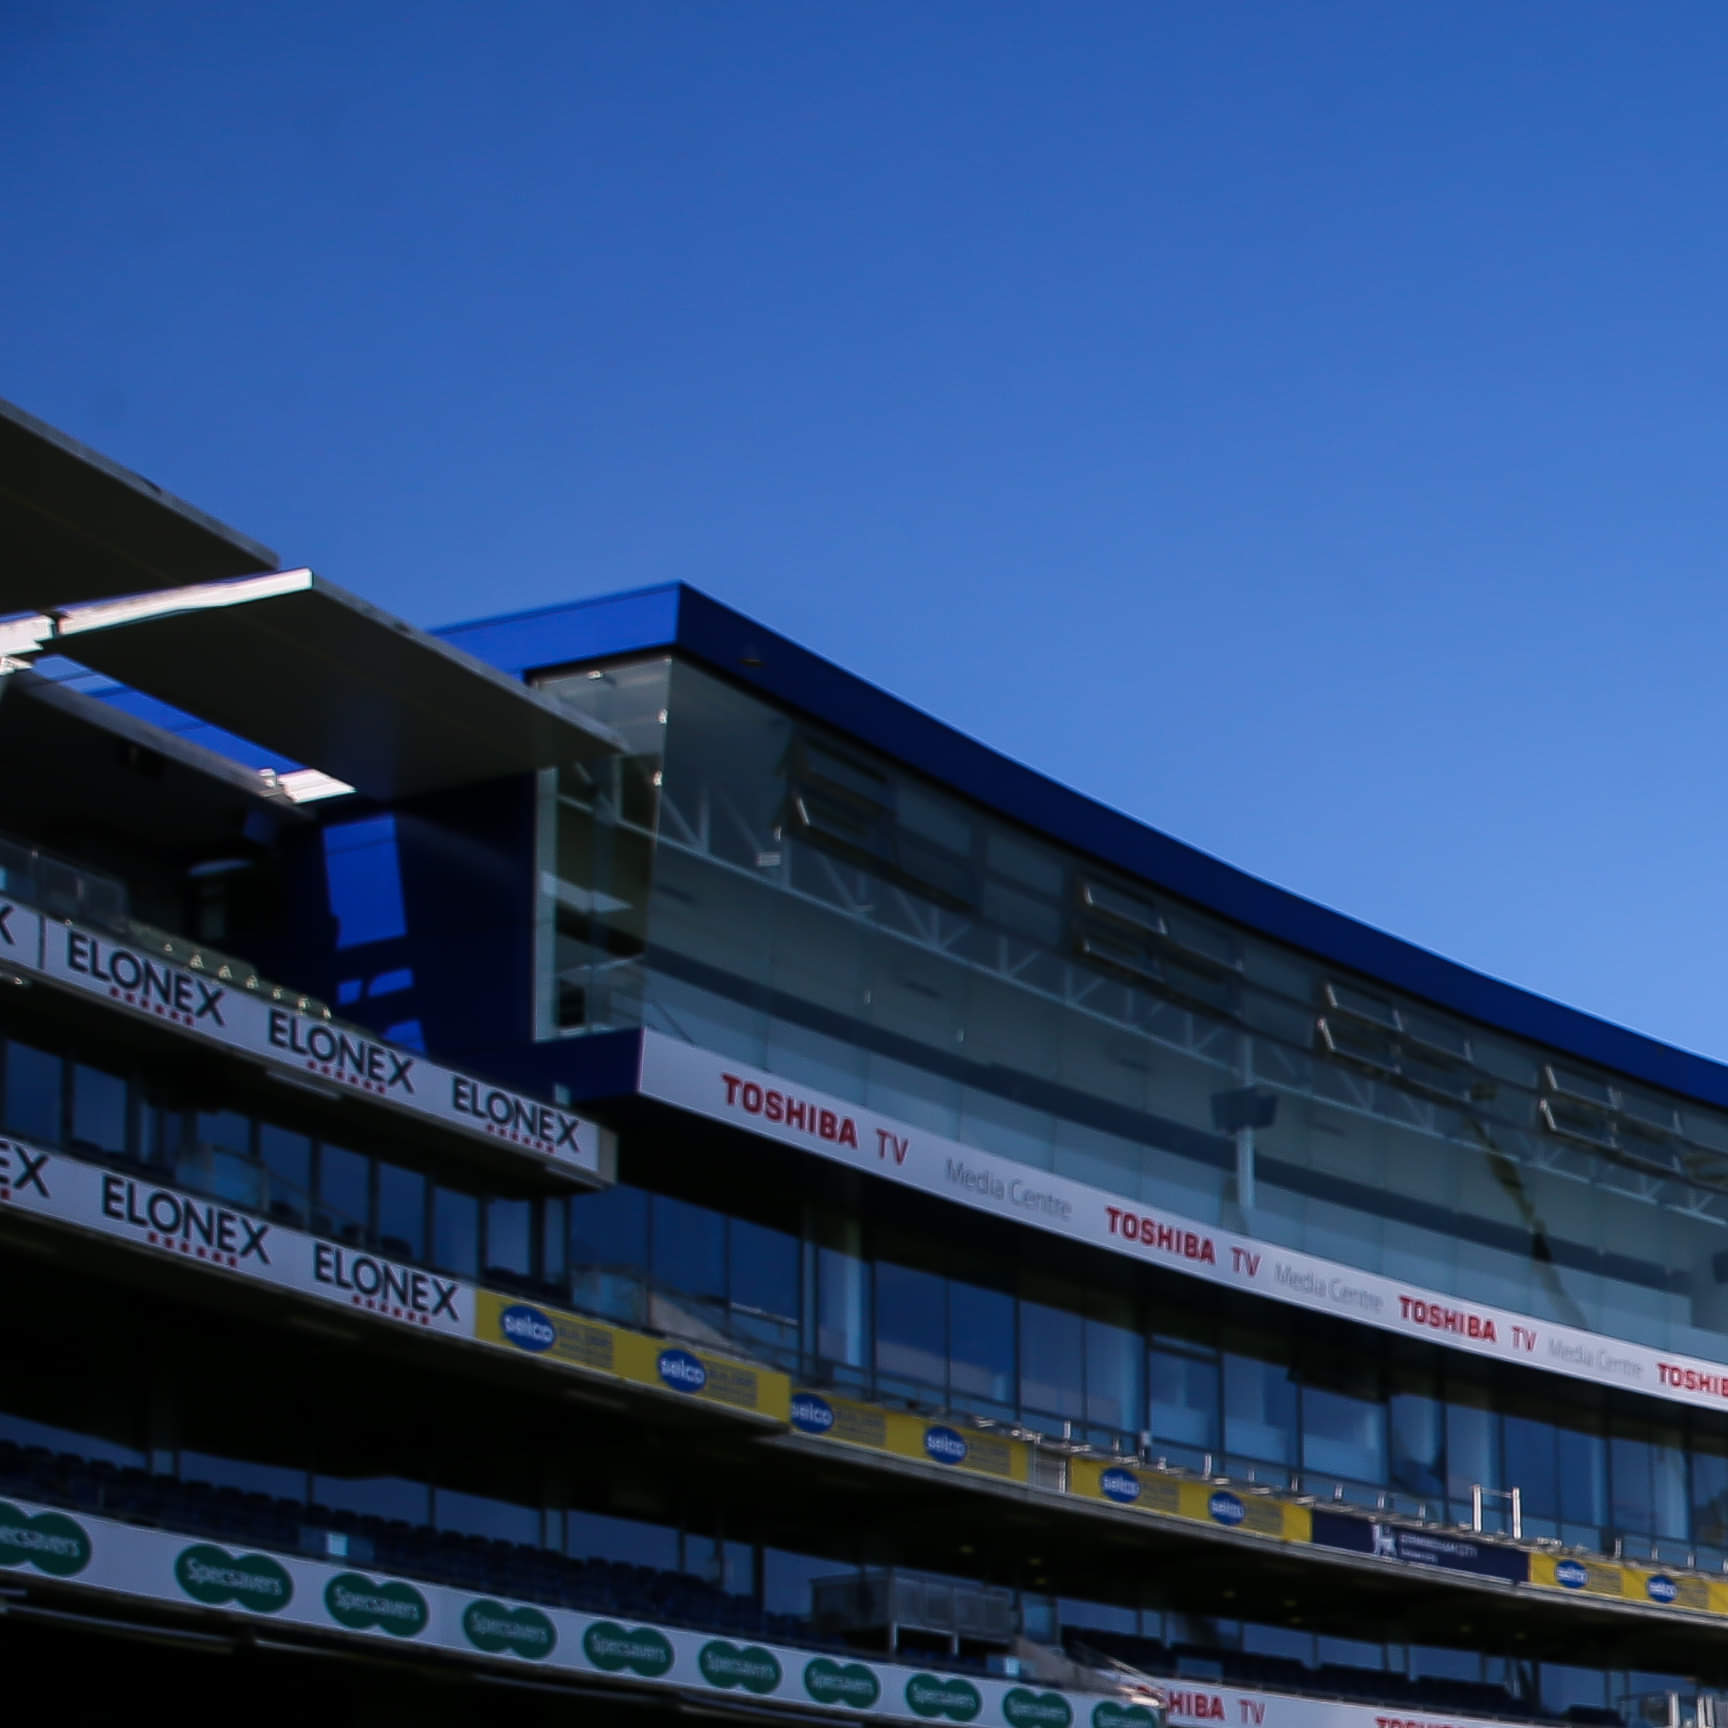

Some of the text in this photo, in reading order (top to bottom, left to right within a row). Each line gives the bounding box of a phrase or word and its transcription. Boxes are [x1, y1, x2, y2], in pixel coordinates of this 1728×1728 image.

[67, 928, 225, 1026] ELONEX
[268, 1008, 414, 1093] ELONEX
[453, 1077, 579, 1152] ELONEX
[721, 1072, 910, 1166] TOSHIBA TV
[102, 1174, 271, 1264] ELONEX
[1106, 1205, 1262, 1277] TOSHIBA TV
[313, 1242, 459, 1321] ELONEX
[504, 1316, 553, 1343] selco
[1399, 1295, 1537, 1353] TOSHIBA TV
[660, 1358, 704, 1384] selco
[0, 1526, 79, 1557] ecsavers
[185, 1557, 283, 1595] Specsavers
[332, 1584, 420, 1620] Specsavers
[470, 1610, 548, 1643] Specsavers
[592, 1633, 666, 1664] Specsavers
[1240, 1699, 1265, 1725] TV
